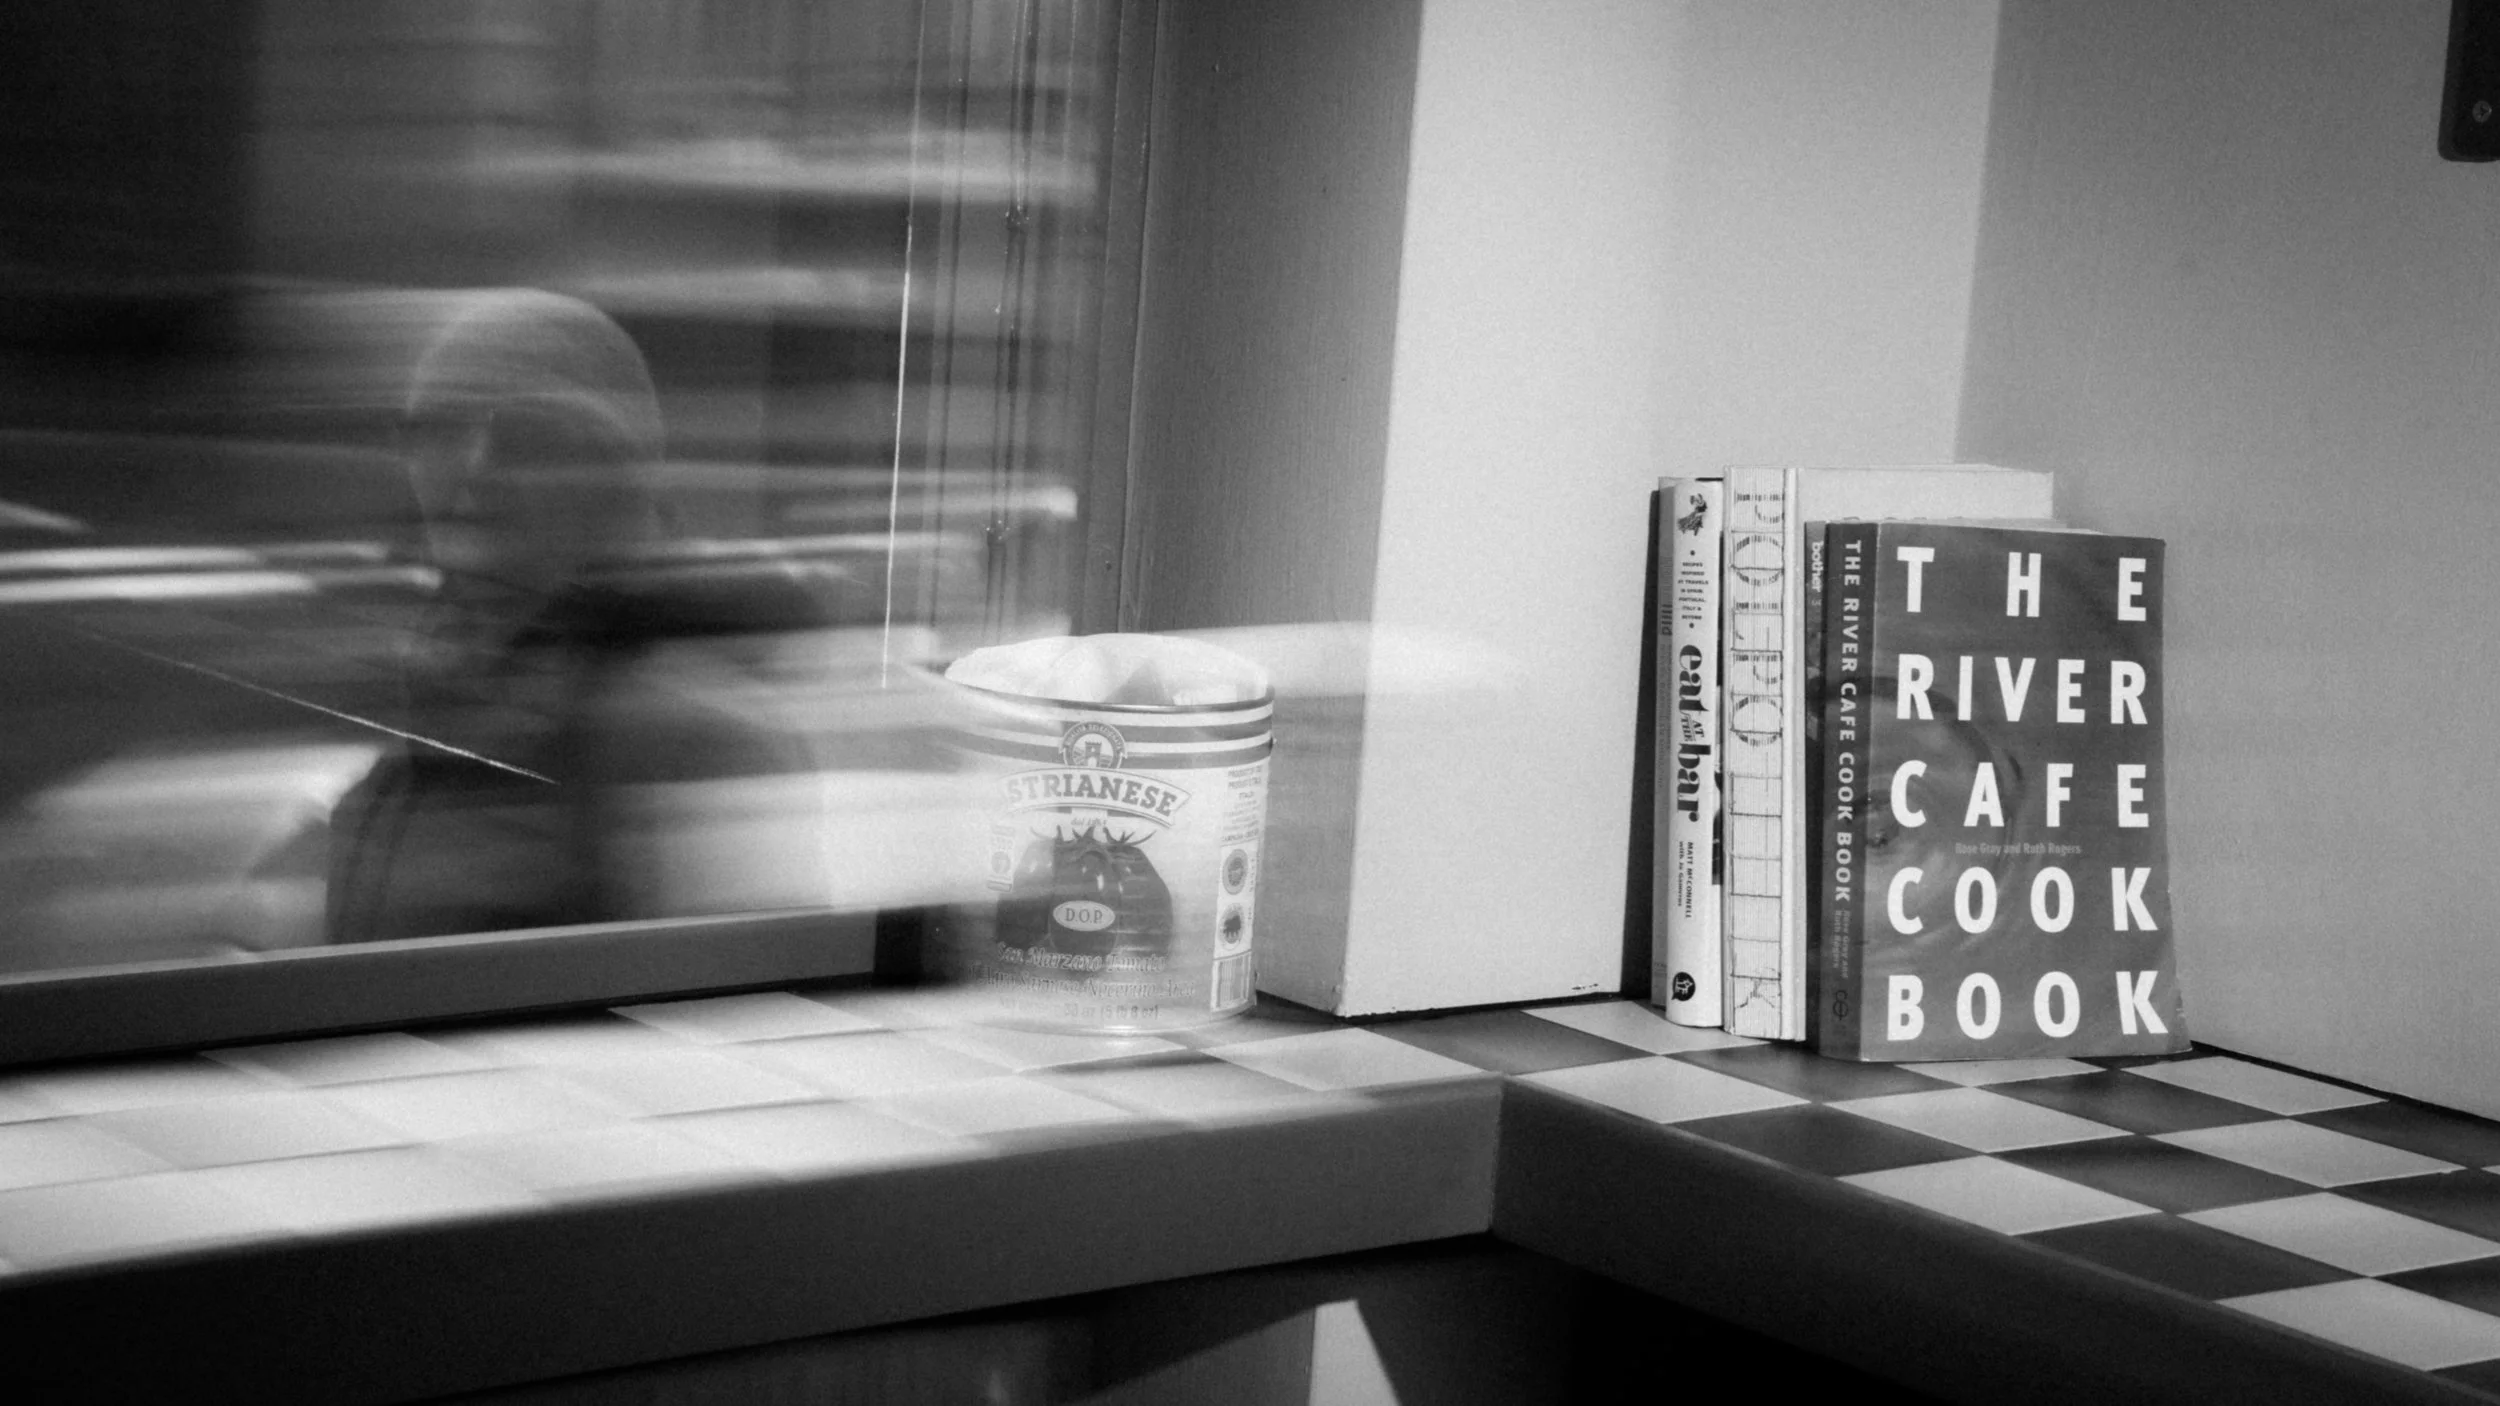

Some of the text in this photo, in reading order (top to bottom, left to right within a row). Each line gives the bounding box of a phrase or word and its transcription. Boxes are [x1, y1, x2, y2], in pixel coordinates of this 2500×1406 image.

[1896, 545, 2148, 622] THE
[1732, 492, 1785, 747] POLPO
[1835, 540, 1862, 902] THE RIVER CAFE COOK BOOK
[1896, 652, 2149, 725] RIVER
[1677, 644, 1712, 822] eat AT THE bar
[1006, 773, 1178, 818] STRIANESE
[1890, 759, 2151, 829] CAFE
[1686, 841, 1694, 864] MATT
[1955, 842, 2082, 857] Rose Gray and Ruth Rogers
[1887, 865, 2160, 935] COOK
[1026, 946, 1101, 973] Marzano
[1886, 970, 2170, 1042] BOOK
